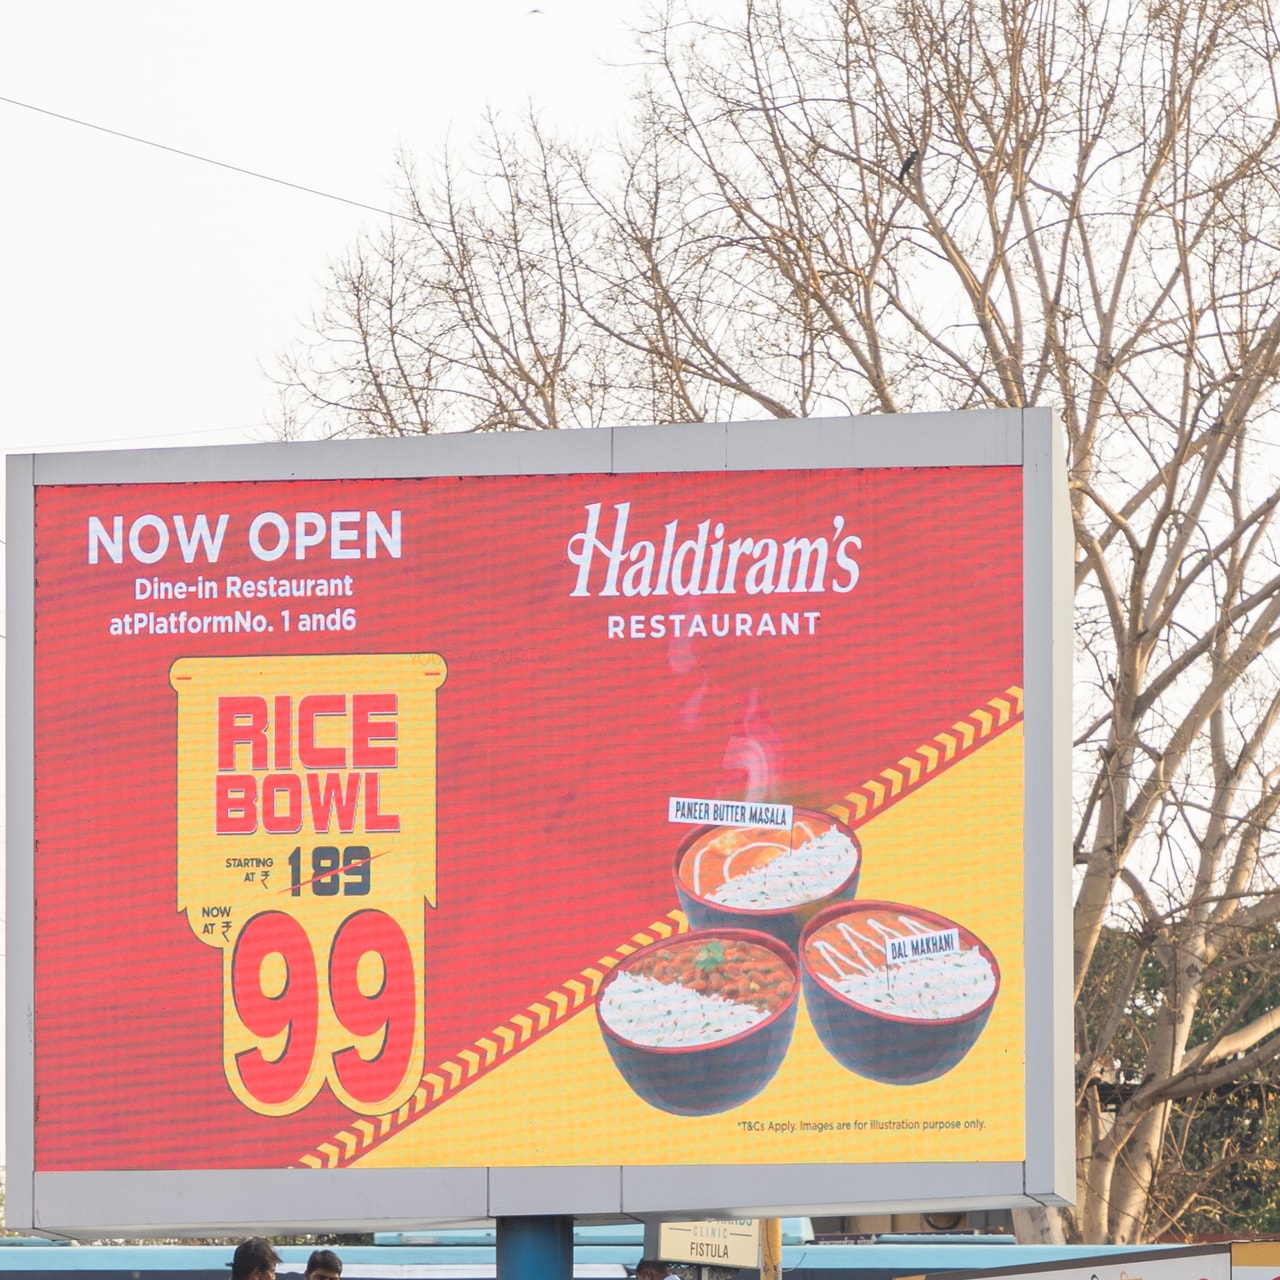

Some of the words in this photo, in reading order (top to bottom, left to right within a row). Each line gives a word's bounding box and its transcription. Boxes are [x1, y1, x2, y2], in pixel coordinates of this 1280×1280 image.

[87, 513, 229, 564] NOW
[248, 510, 402, 561] OPEN
[567, 501, 862, 597] Haldiram's
[135, 575, 218, 600] Dine-in
[227, 574, 353, 599] Restaurant
[281, 608, 291, 632] 1
[297, 606, 356, 631] and6
[607, 612, 820, 639] RESTAURANT
[217, 693, 398, 771] RICE
[215, 771, 401, 835] BOWL
[675, 800, 711, 820] PANEER
[713, 802, 746, 823] BUTTER
[749, 806, 787, 826] MASALA
[225, 857, 274, 869] STARTING
[287, 846, 371, 896] 189
[244, 872, 256, 882] AT
[201, 906, 231, 918] NOW
[202, 923, 215, 934] AT
[891, 939, 907, 960] DAL
[910, 934, 955, 957] MAKHANI
[231, 909, 416, 1105] 99
[768, 1122, 797, 1134] Apply.
[800, 1121, 832, 1134] Images
[833, 1123, 851, 1132] are
[853, 1120, 867, 1131] for
[869, 1119, 920, 1131] illustration
[922, 1121, 961, 1133] purpose
[963, 1119, 986, 1132] only.
[693, 1226, 728, 1239] CLINIC
[690, 1241, 730, 1259] FISTULA
